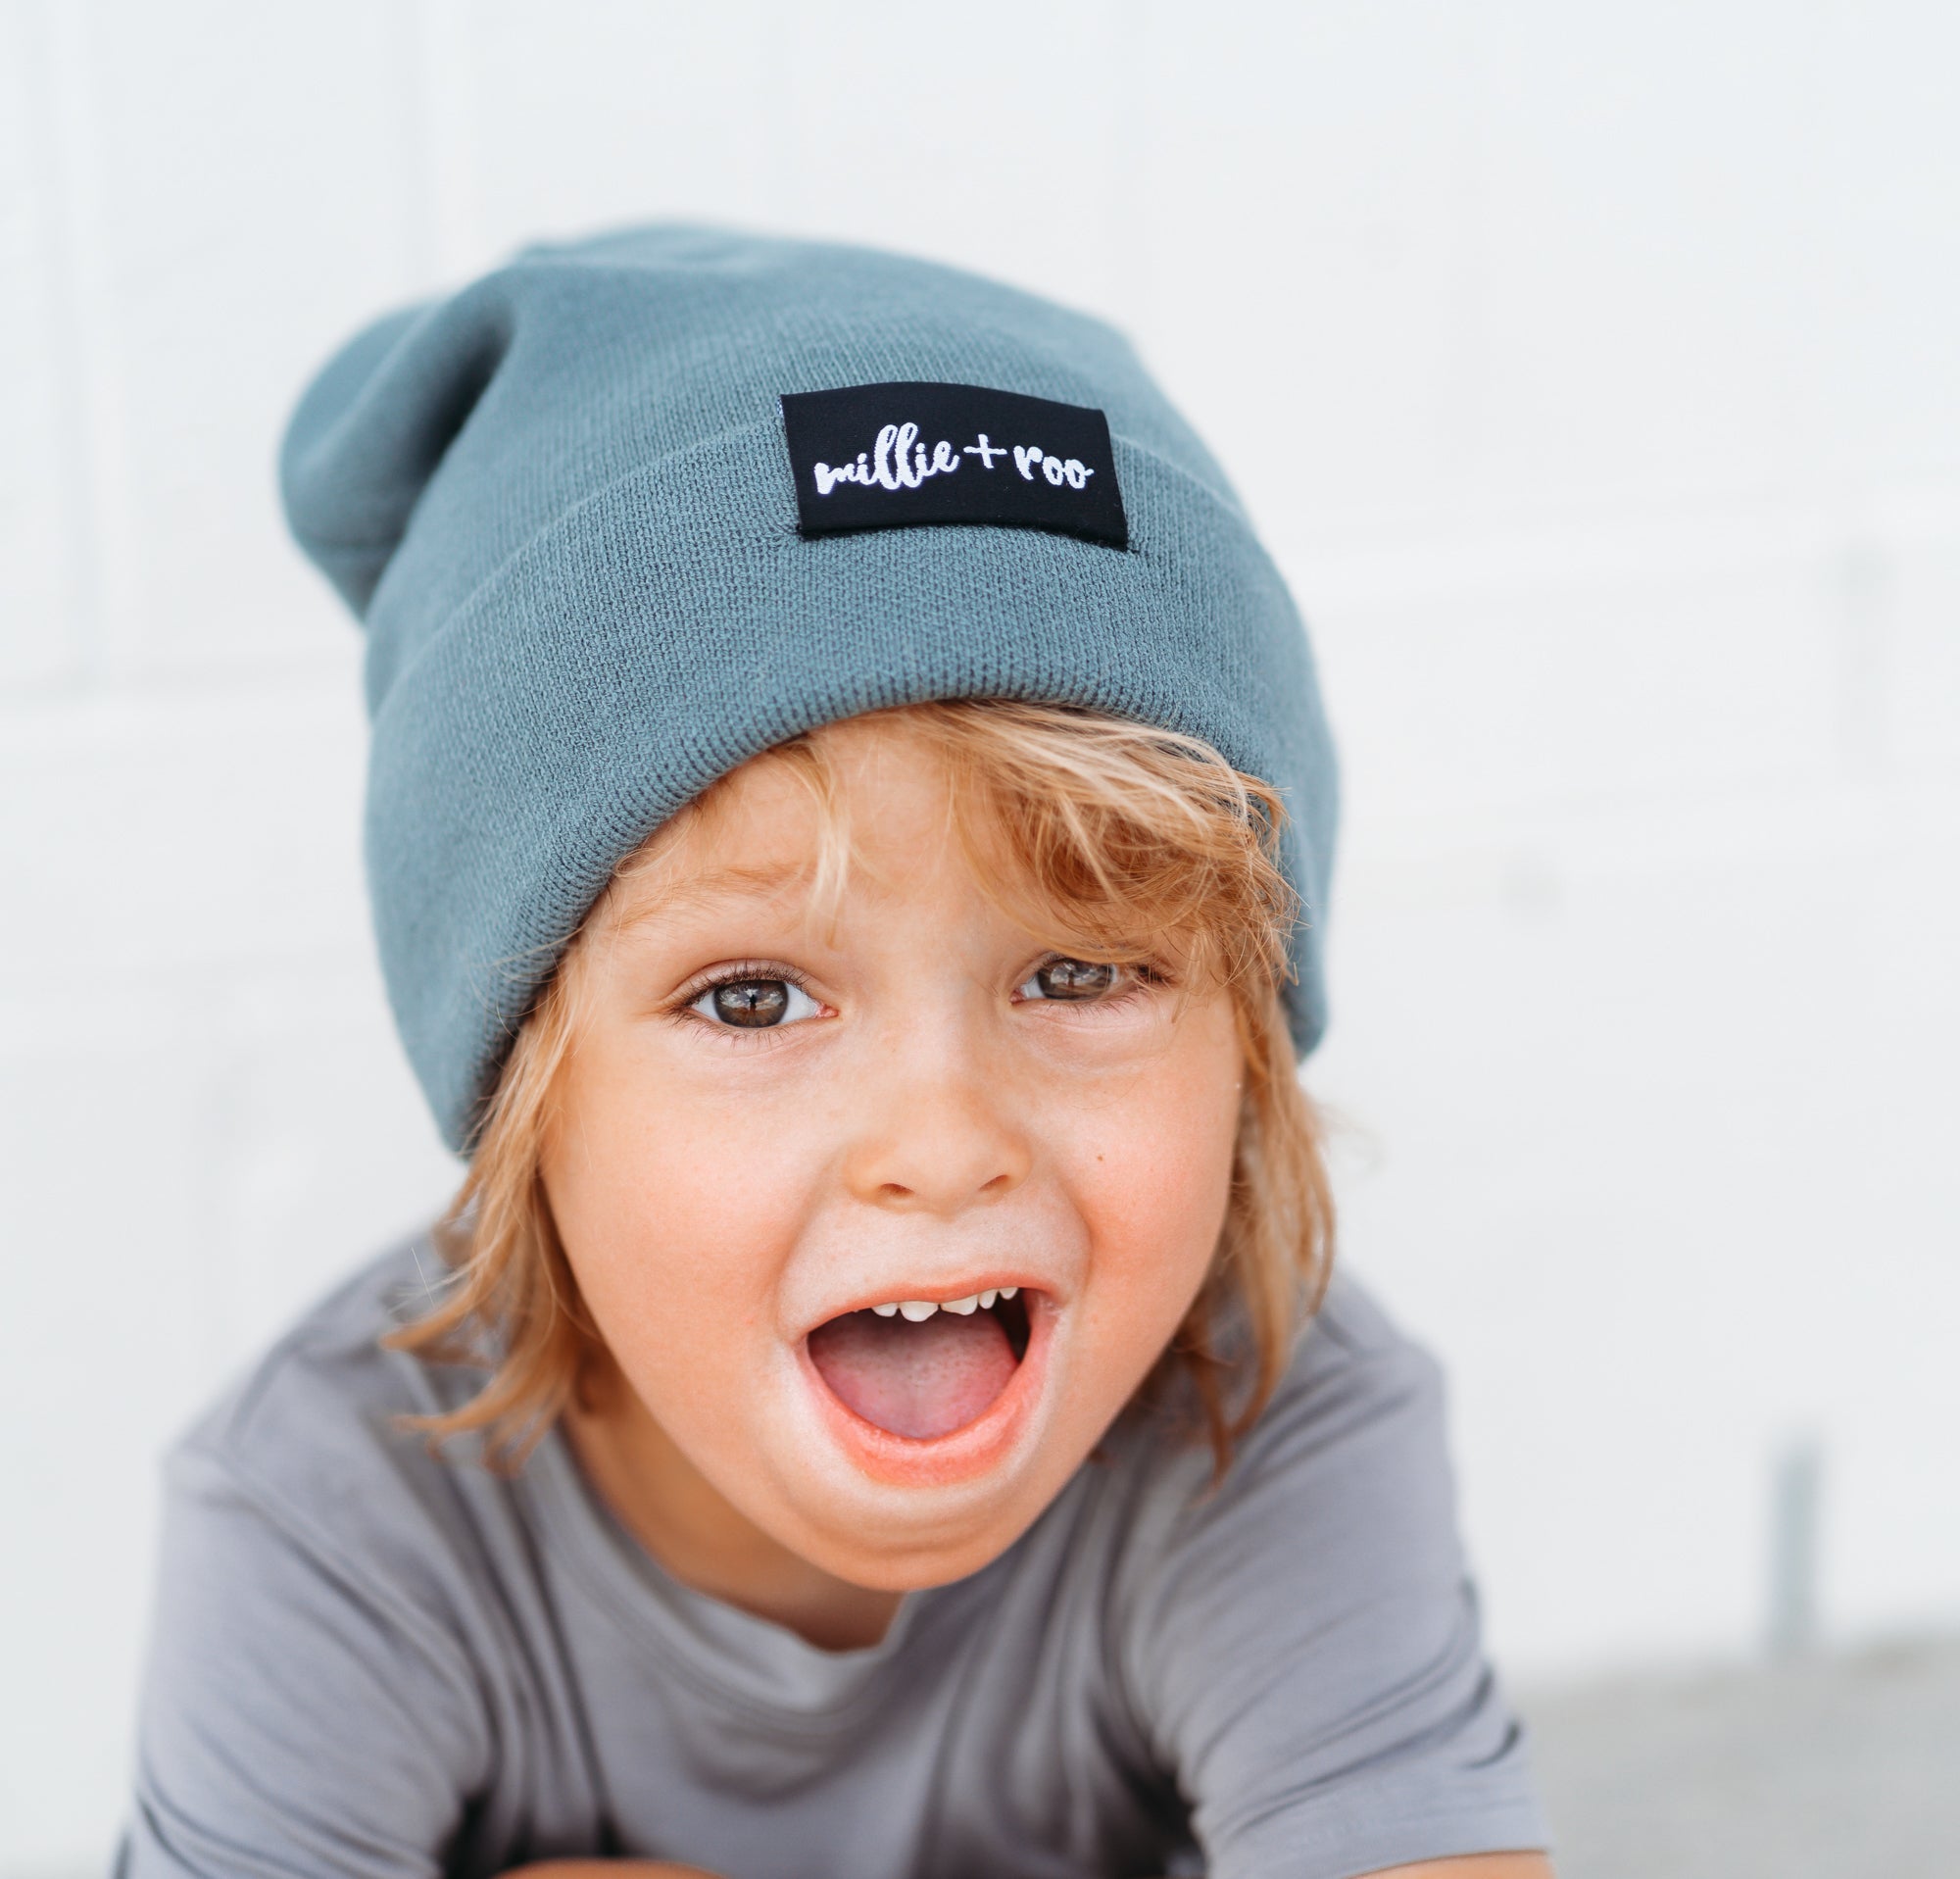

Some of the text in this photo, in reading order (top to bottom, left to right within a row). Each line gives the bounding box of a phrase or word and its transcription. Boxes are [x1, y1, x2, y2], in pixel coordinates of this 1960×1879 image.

[813, 421, 1095, 495] millie + roo
